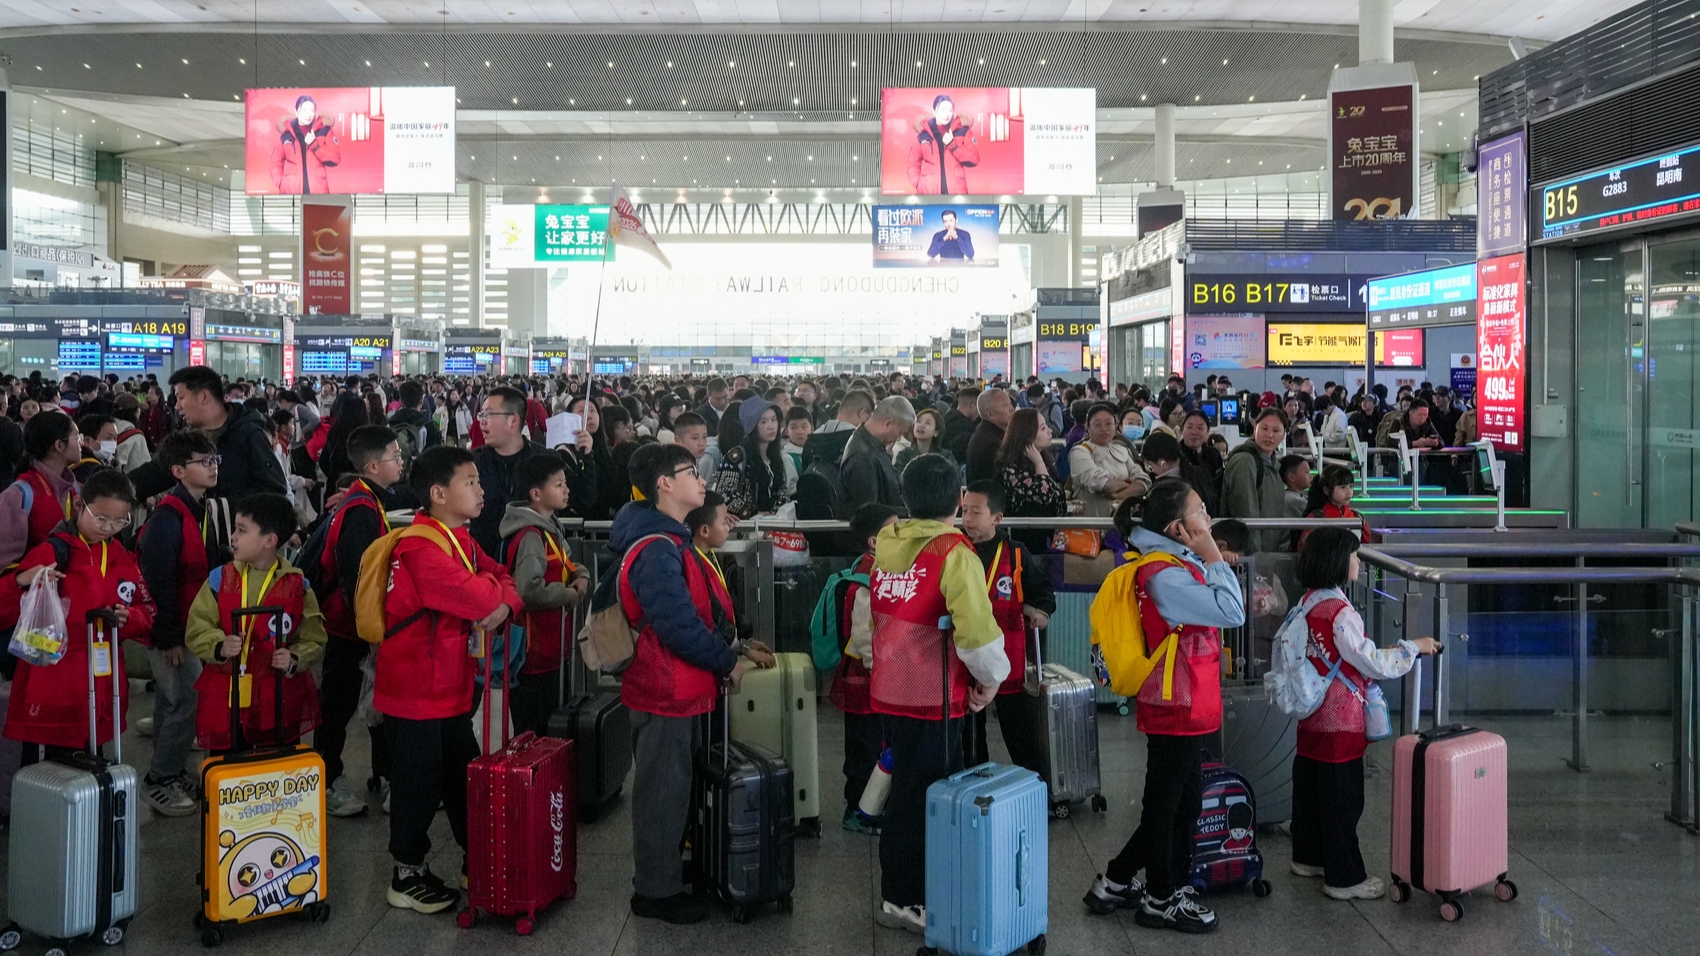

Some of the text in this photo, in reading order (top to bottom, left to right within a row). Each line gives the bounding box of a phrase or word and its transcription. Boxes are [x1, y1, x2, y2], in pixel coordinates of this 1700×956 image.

[1347, 134, 1398, 153] 兔宝宝
[1338, 151, 1407, 169] 上市20周年
[1609, 170, 1621, 181] 车次
[1656, 167, 1683, 187] 昆明南
[1602, 181, 1628, 197] G2883
[1493, 157, 1501, 240] 商务座便捷
[1503, 169, 1512, 238] 检票通道
[1545, 185, 1578, 220] B15
[544, 214, 590, 230] 兔宝宝
[877, 208, 924, 226] 看过欧派
[544, 230, 605, 246] 让家更好
[877, 227, 912, 244] 再装家
[308, 269, 346, 279] 抢高铁C位
[1194, 284, 1288, 304] B16 B17
[1311, 285, 1339, 294] 检票口
[1483, 283, 1518, 301] 标准化家具
[133, 322, 186, 335] A18 A19
[1041, 323, 1094, 337] B18 B19
[353, 338, 389, 347] A20 A21
[983, 339, 1001, 348] B20
[952, 347, 966, 355] B22
[1480, 343, 1520, 371] 合伙人
[877, 578, 920, 603] 更精彩
[219, 774, 319, 806] HAPPY DAY
[1197, 814, 1226, 826] CLASSIC
[1200, 823, 1225, 835] TEDDY
